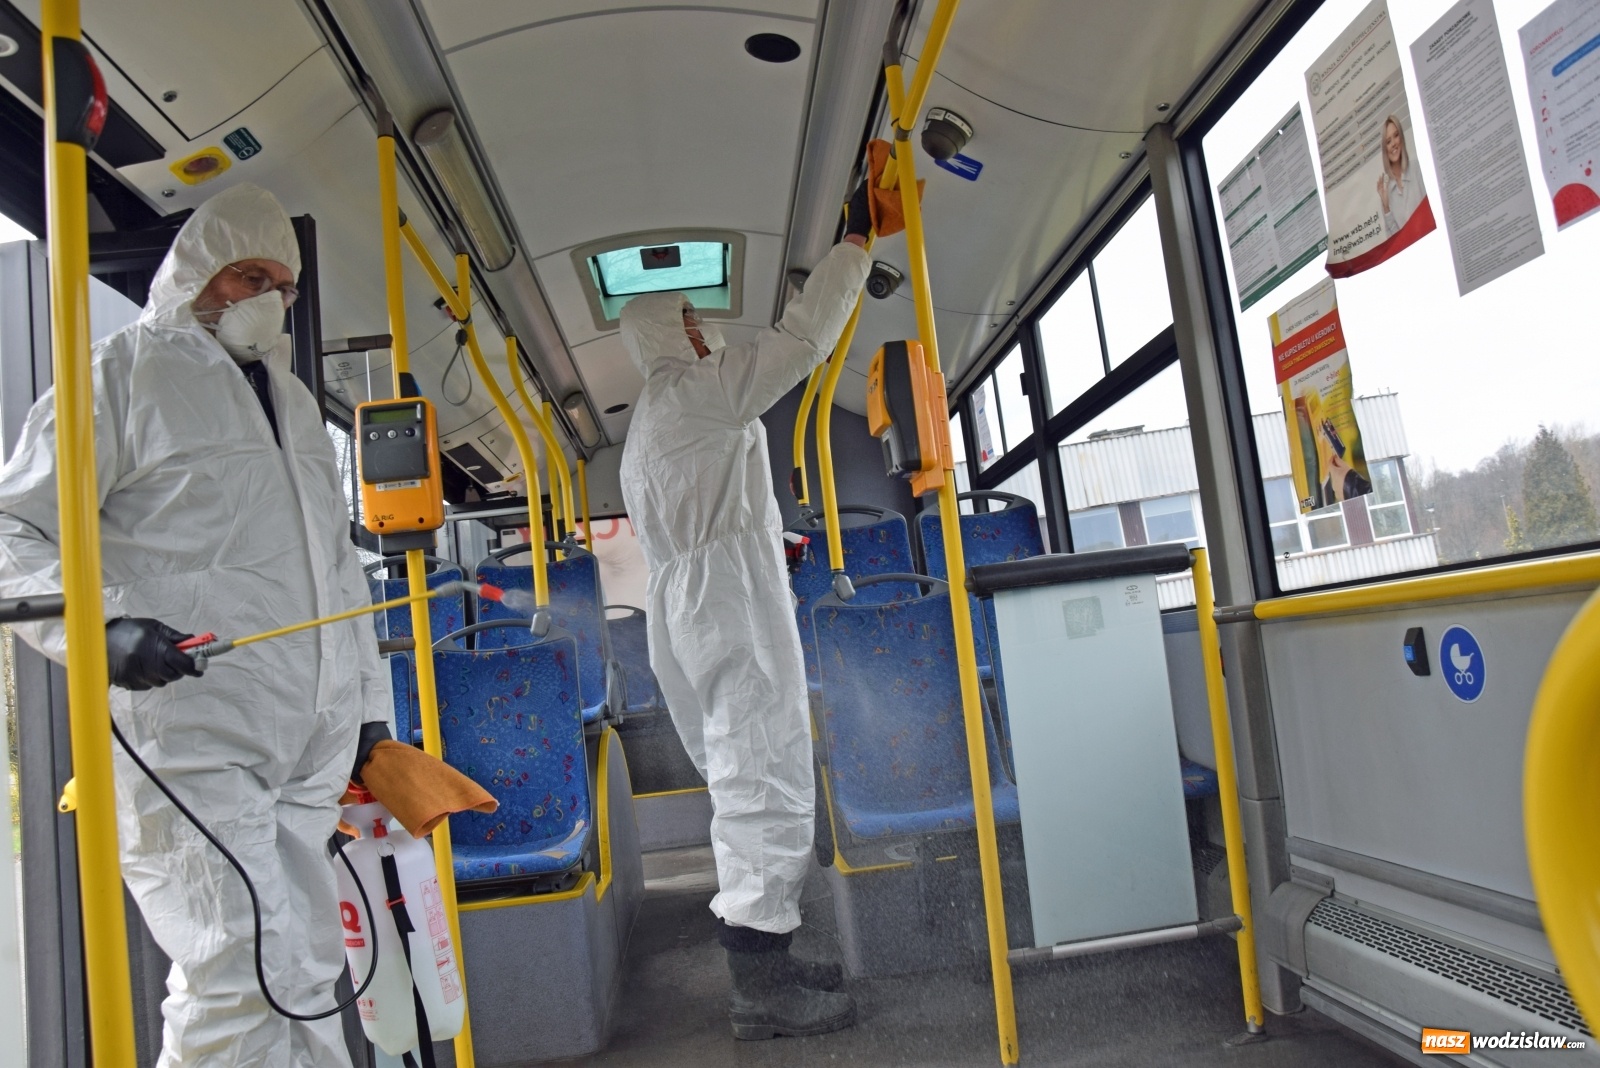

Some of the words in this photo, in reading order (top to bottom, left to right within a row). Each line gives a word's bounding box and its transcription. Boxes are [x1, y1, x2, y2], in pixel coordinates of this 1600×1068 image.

[1332, 211, 1379, 245] www.wsb.net.pl
[1333, 223, 1382, 256] info@wsb.net.pl
[1314, 322, 1337, 341] KIEROWCY
